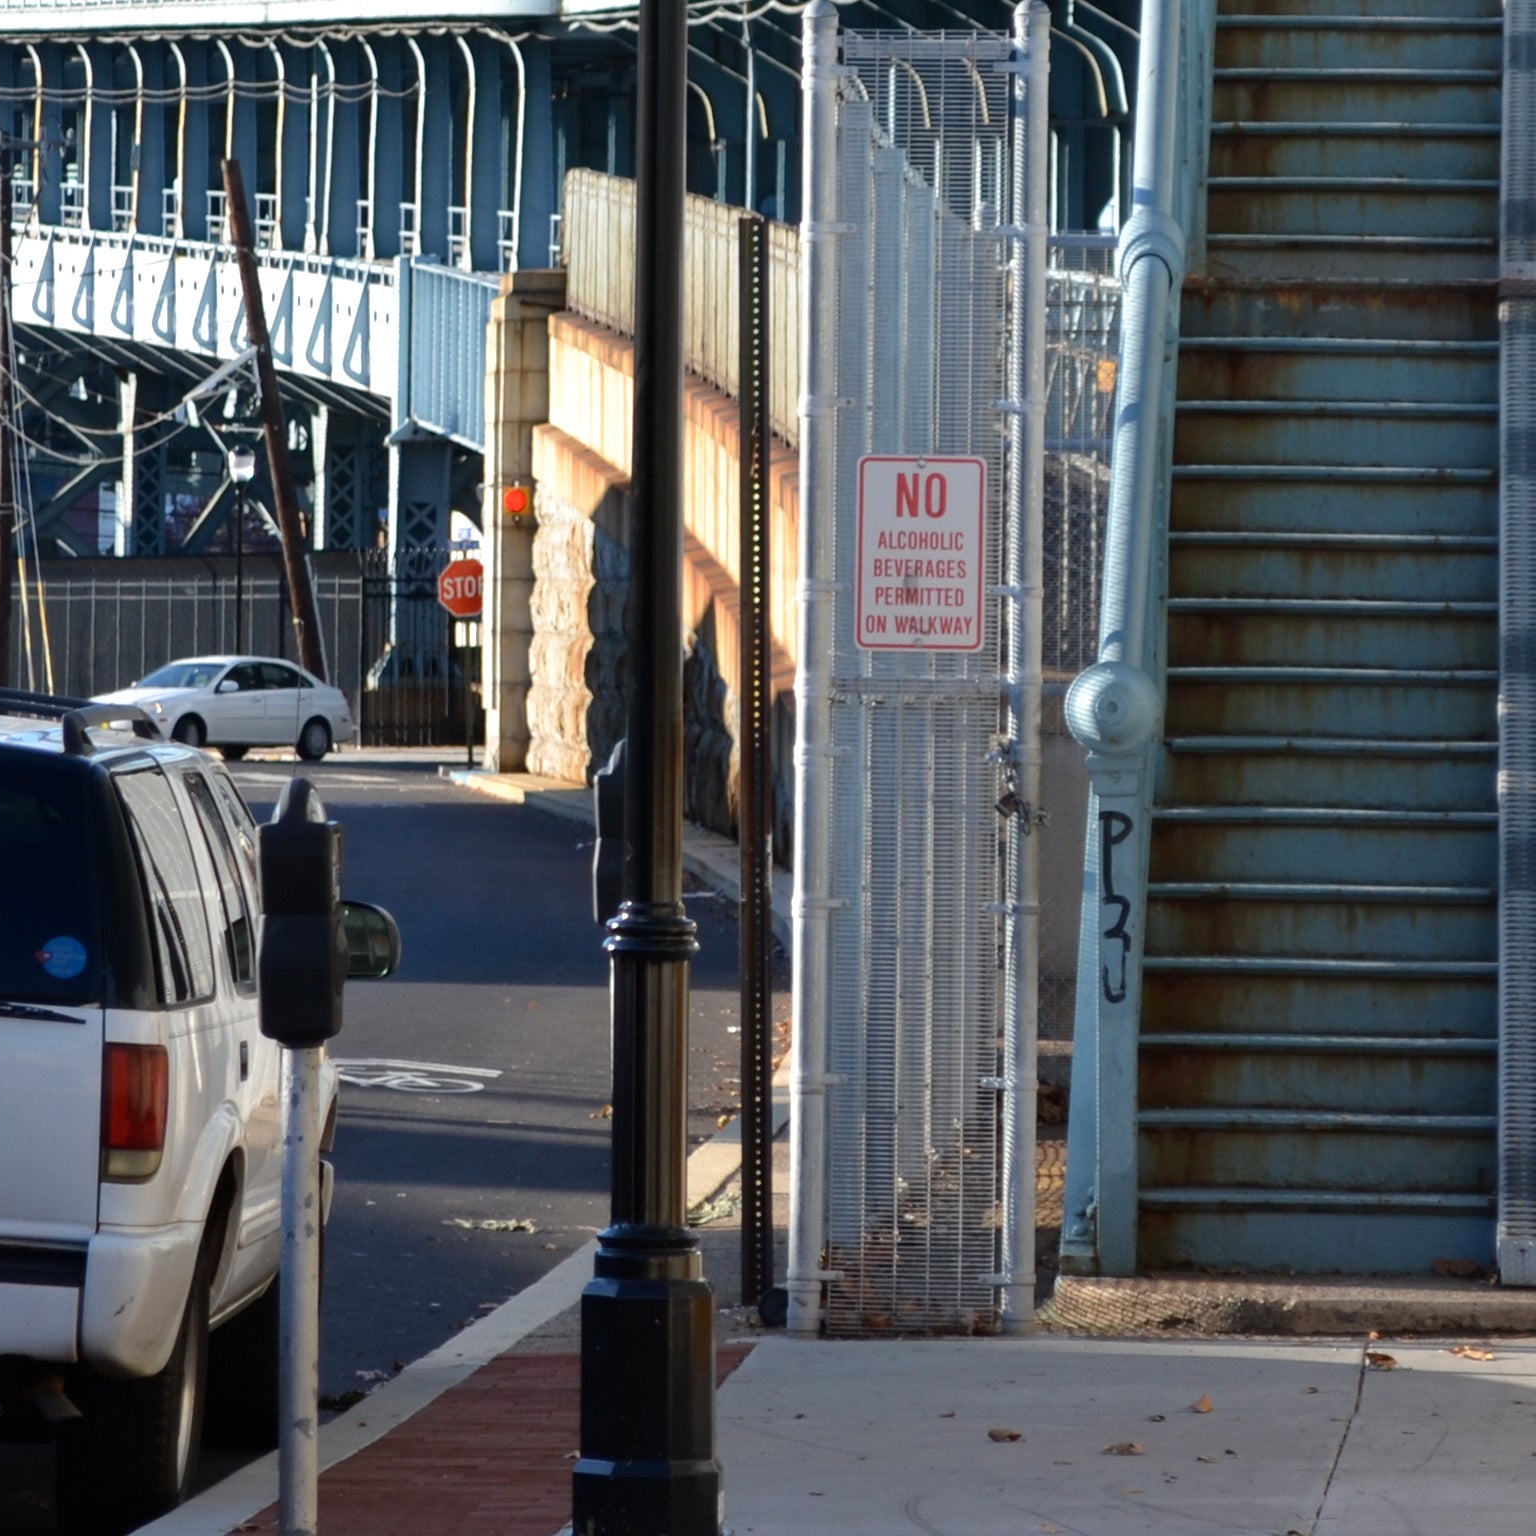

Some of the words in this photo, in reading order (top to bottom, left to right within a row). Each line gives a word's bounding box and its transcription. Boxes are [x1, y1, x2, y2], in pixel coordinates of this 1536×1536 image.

[896, 472, 947, 519] NO
[877, 530, 964, 551] ALCOHOLIC
[873, 558, 967, 579] BEVERAGES
[874, 586, 965, 607] PERMITTED
[866, 615, 887, 634] ON
[894, 616, 973, 635] WALKWAY
